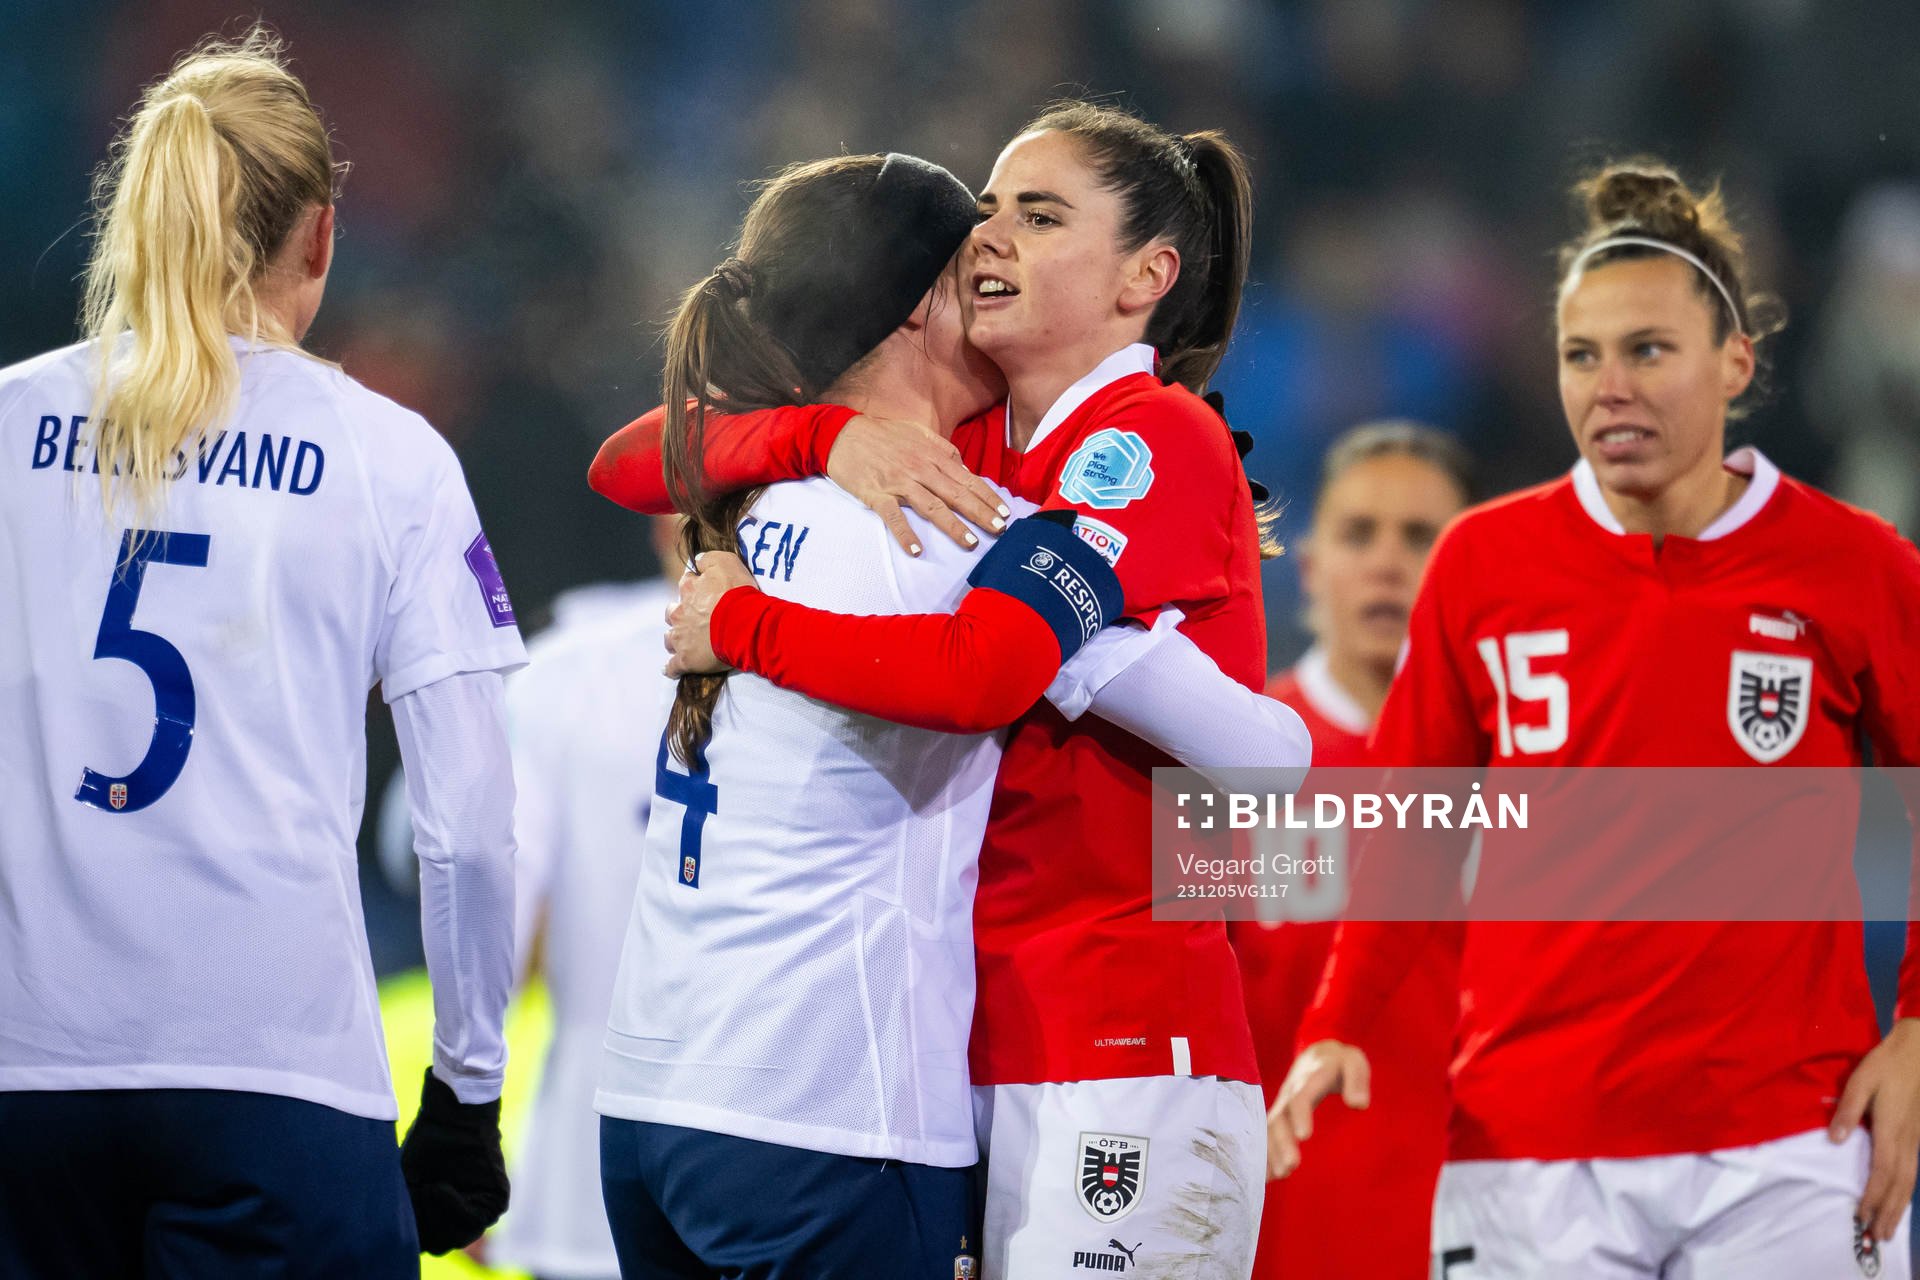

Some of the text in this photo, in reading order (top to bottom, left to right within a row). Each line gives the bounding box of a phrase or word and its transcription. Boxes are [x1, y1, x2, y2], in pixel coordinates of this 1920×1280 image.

[1093, 451, 1107, 461] We
[1086, 460, 1109, 473] play
[74, 528, 211, 813] 5
[1477, 628, 1570, 758] 15
[655, 690, 719, 890] 4
[1094, 1037, 1147, 1047] ULTRAWEAVE
[1099, 1137, 1129, 1150] ÖFB
[1072, 1251, 1126, 1273] PUMA
